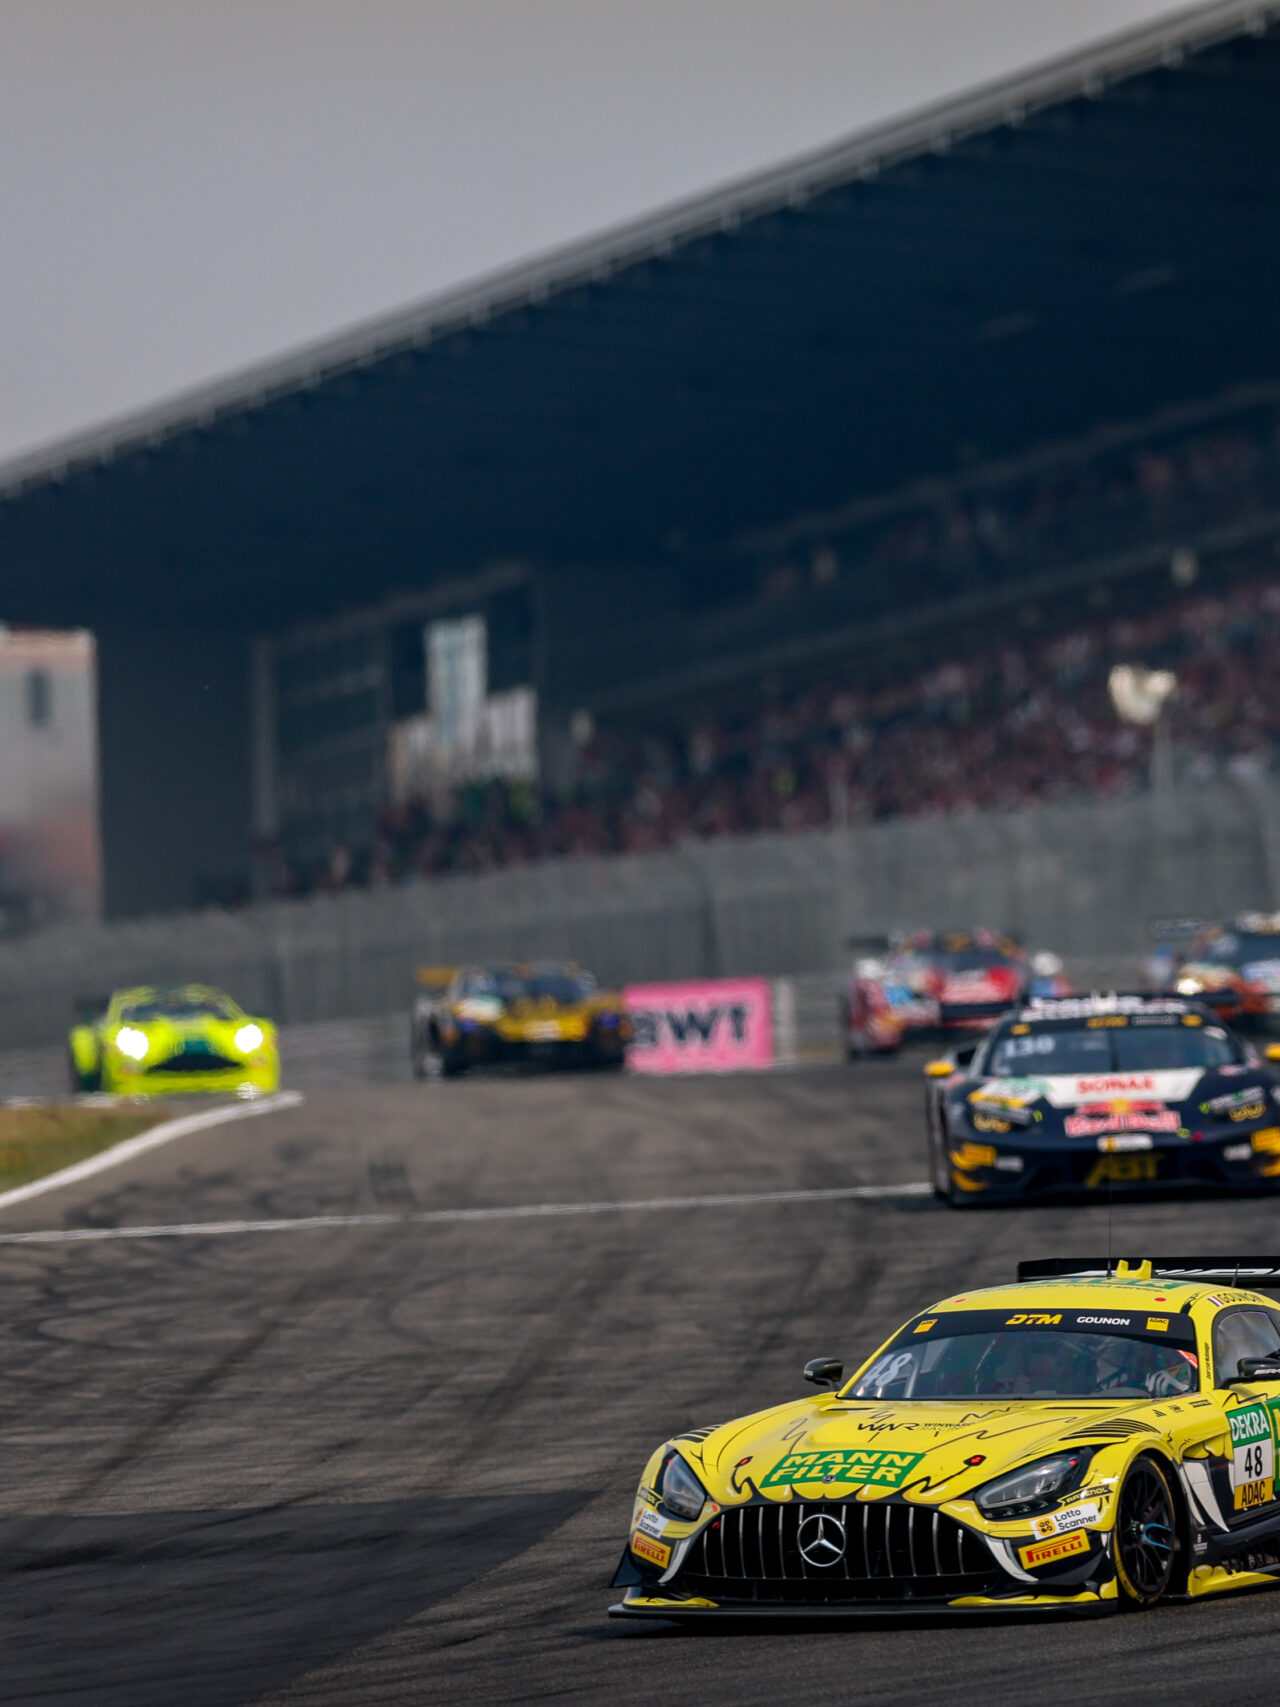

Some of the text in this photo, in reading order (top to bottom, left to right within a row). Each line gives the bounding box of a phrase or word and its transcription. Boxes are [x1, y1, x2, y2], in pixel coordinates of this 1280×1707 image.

[1005, 1314, 1130, 1326] DTM GOUNON
[859, 1353, 913, 1387] 48
[1229, 1408, 1270, 1442] DEKRA
[781, 1452, 915, 1467] MANN
[1244, 1445, 1263, 1479] 48
[769, 1464, 903, 1482] FILTER
[1240, 1481, 1266, 1507] ADAC
[1054, 1509, 1082, 1522] Lotto
[1057, 1515, 1097, 1531] Scanner
[634, 1536, 666, 1562] PIRELLI
[1026, 1535, 1083, 1563] PIRELLI
